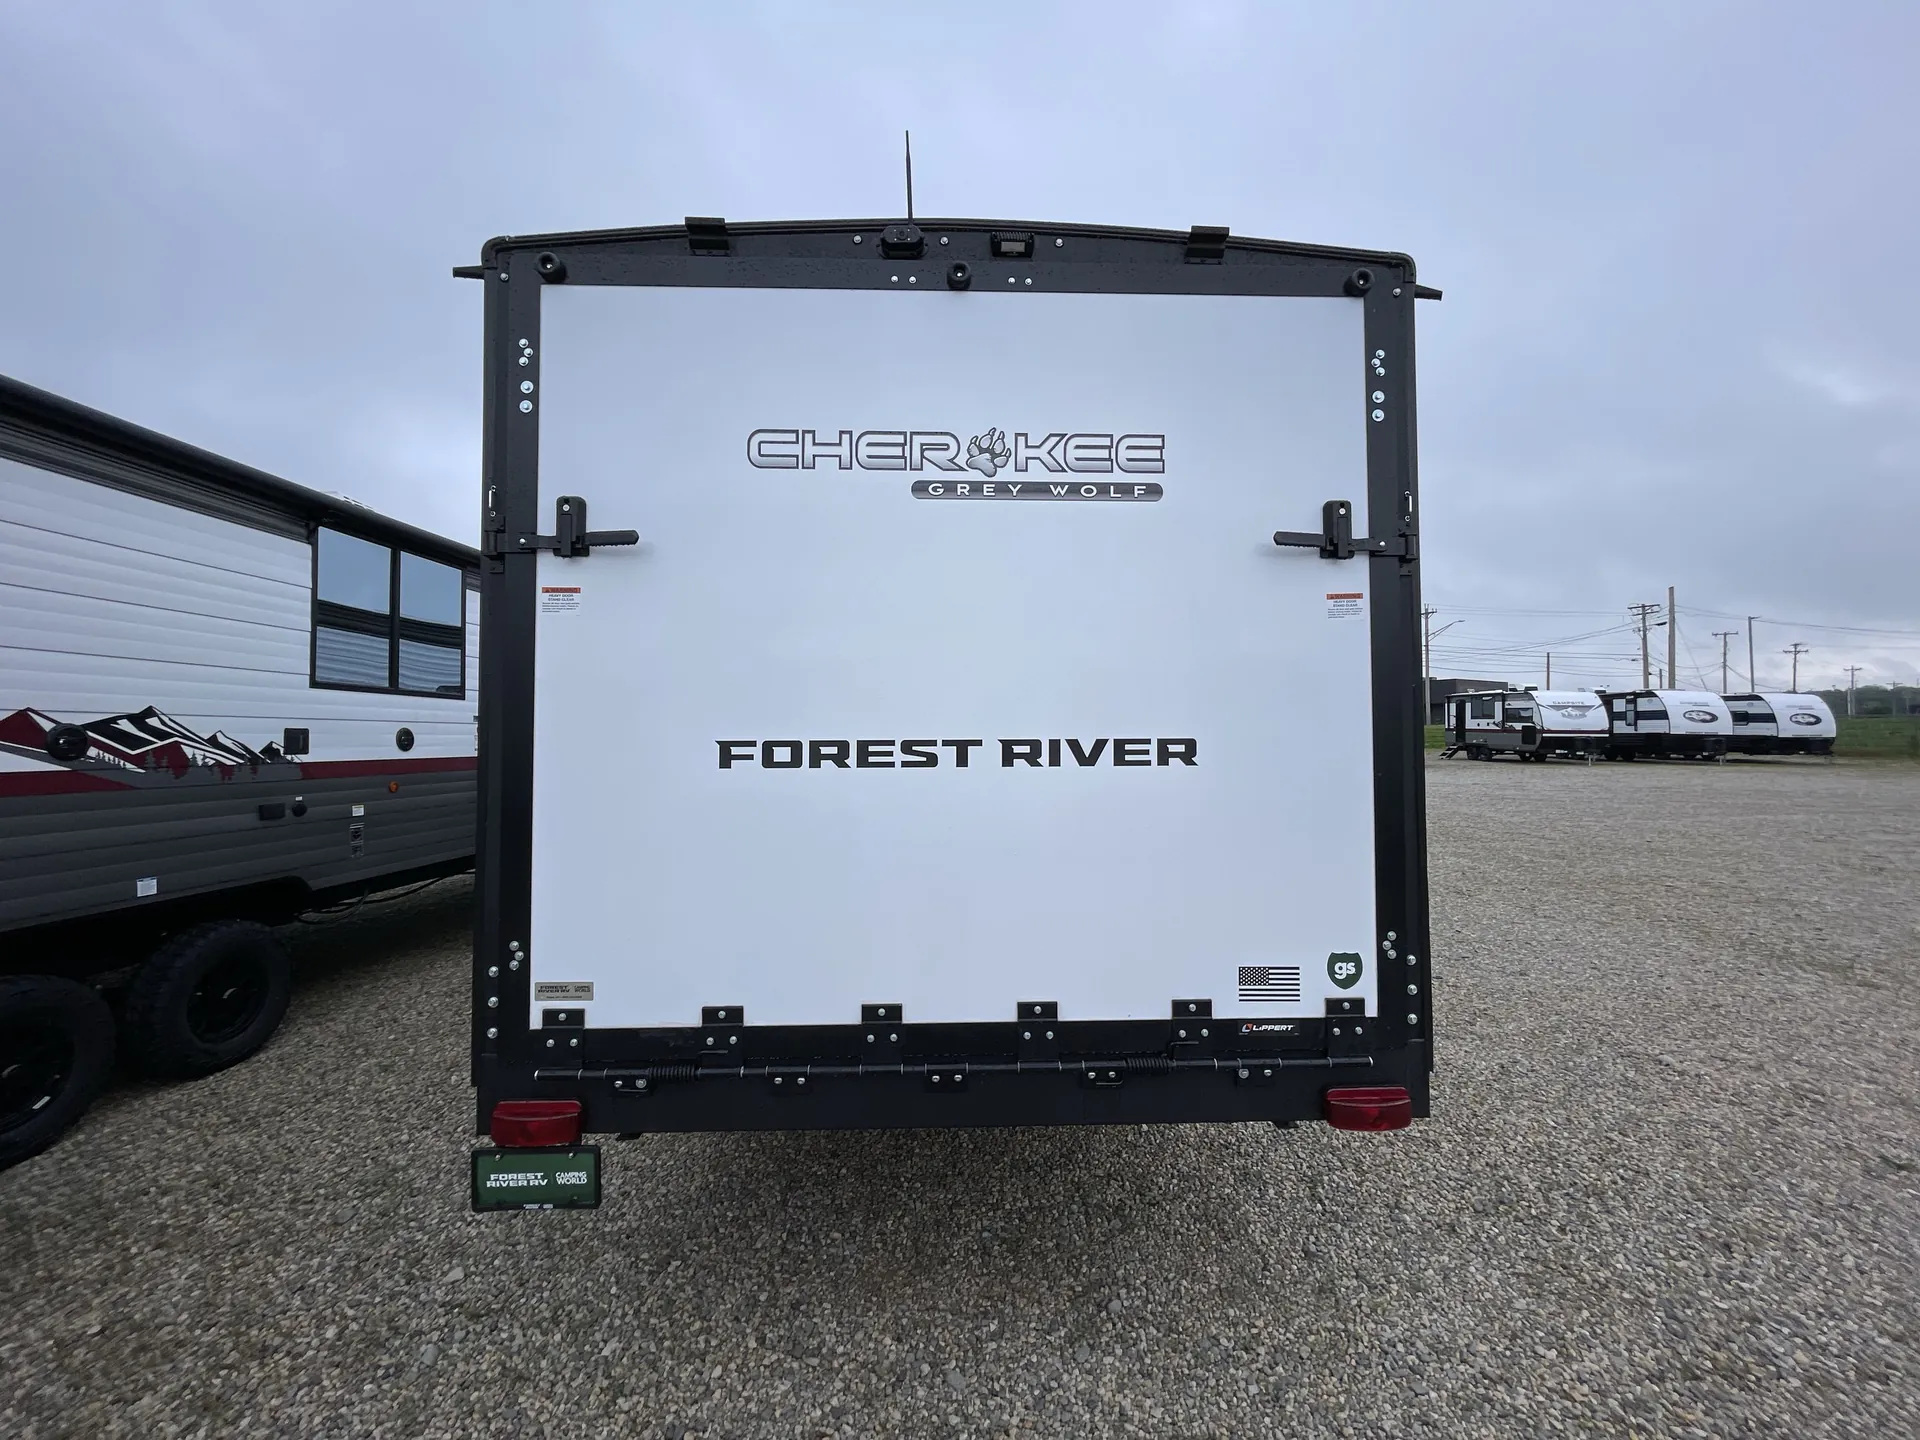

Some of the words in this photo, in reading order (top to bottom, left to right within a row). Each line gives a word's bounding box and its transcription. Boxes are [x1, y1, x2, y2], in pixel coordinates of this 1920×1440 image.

[928, 482, 1023, 497] GREY
[1050, 483, 1148, 499] WOLF
[714, 739, 983, 769] FOREST
[997, 738, 1199, 767] RIVER
[1334, 961, 1356, 980] gs
[490, 1172, 544, 1181] FOREST
[555, 1171, 587, 1179] CAMPING
[486, 1179, 528, 1188] RIVER
[556, 1177, 588, 1185] WORLD
